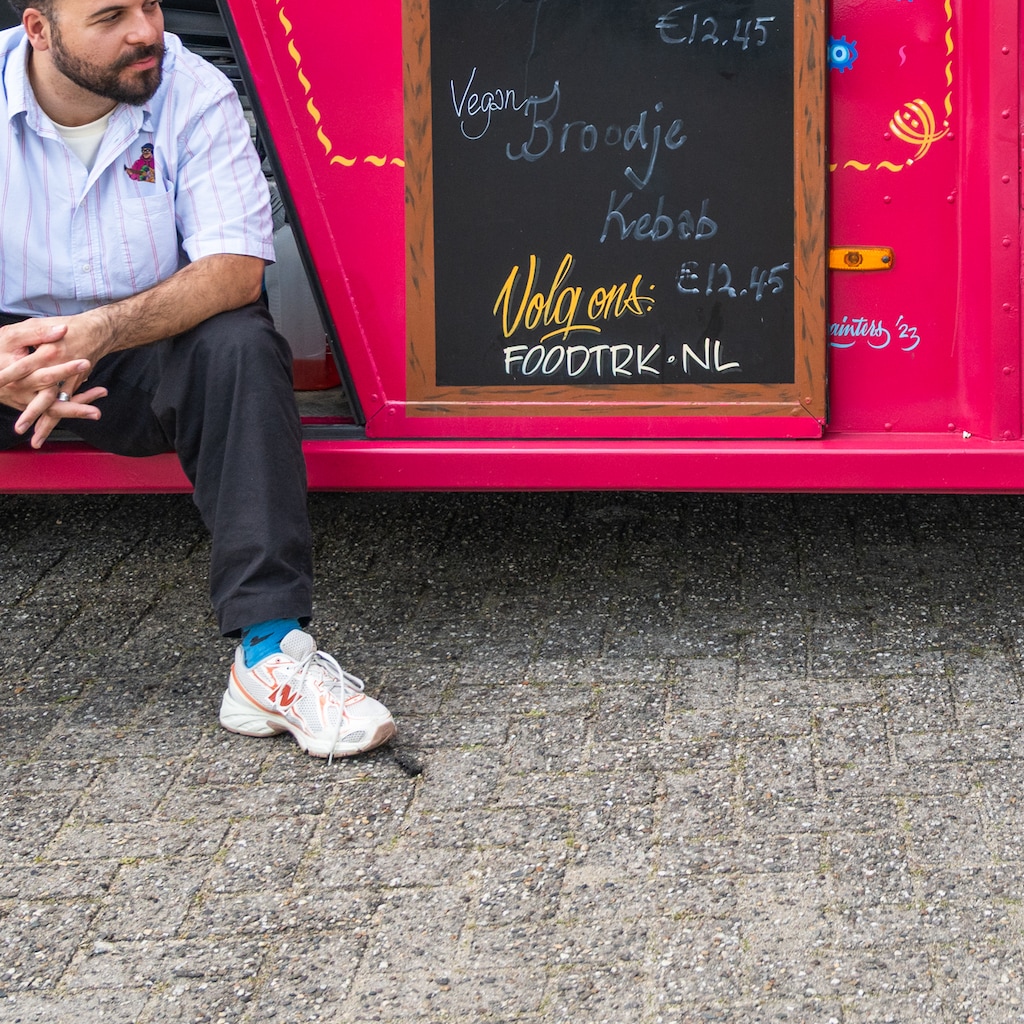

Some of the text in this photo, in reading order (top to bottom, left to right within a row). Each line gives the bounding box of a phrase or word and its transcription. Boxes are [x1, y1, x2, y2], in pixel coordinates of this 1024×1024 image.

[655, 6, 776, 51] €12.45
[451, 67, 529, 140] Vegan
[505, 80, 688, 190] Broodje
[600, 189, 719, 244] Kebab
[493, 253, 656, 343] Volg ons:
[676, 261, 790, 302] €12.45
[829, 314, 921, 352] ainters '23
